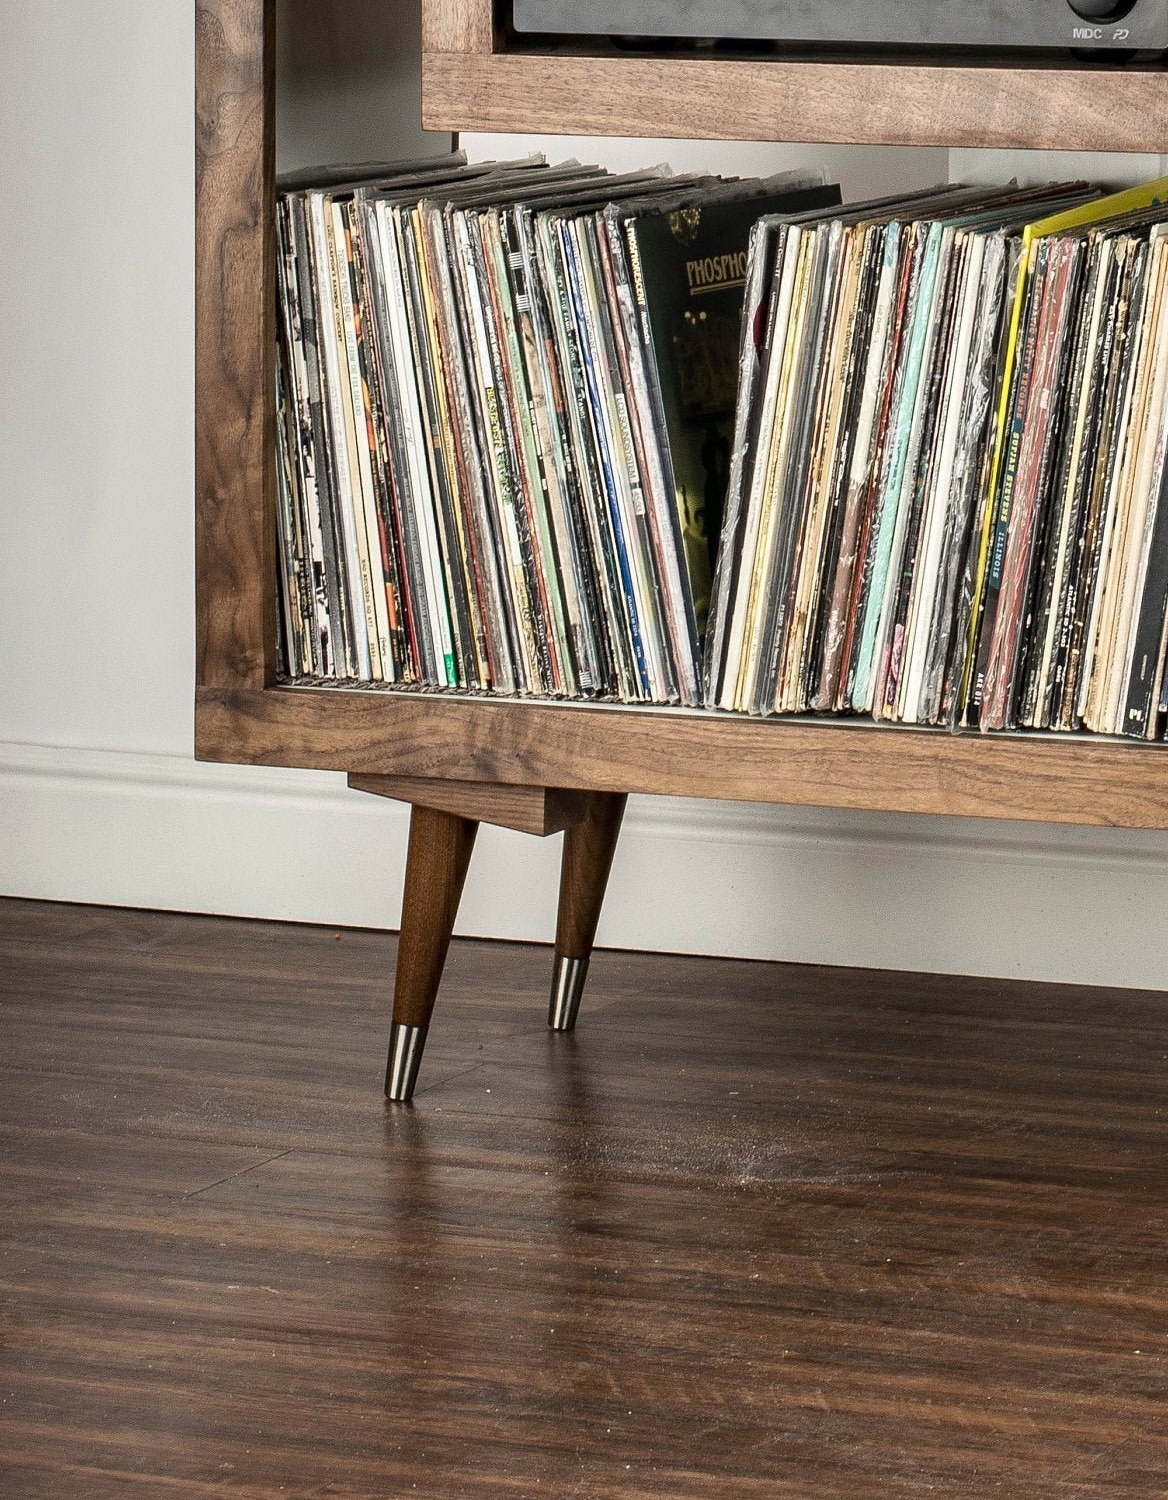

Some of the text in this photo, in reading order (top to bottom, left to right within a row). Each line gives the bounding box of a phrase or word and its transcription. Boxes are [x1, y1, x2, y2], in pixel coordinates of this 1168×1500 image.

[1073, 28, 1102, 39] MDC
[327, 241, 343, 343] CLAPTON'S RAINBOW CONCERT
[626, 226, 651, 345] PHOSPHORESCENT Muchacho
[336, 249, 362, 416] TEDESCHI TRUCKS BAND LIVE FROM THE FOX OAKLAND
[1076, 322, 1086, 348] BROTHERS
[1080, 302, 1088, 322] ALLMAN
[1100, 304, 1114, 365] RAY CHARLES LIVE
[1022, 336, 1034, 369] KITTY
[1074, 347, 1082, 363] BAND
[1014, 371, 1029, 420] RECORDS
[1070, 369, 1079, 393] FILLMORE
[615, 396, 637, 479] LCD SOUNDSYSTEM
[999, 431, 1020, 523] SUFJAN STEVENS
[991, 531, 1005, 579] ILLINOIS
[362, 573, 370, 603] RECORDS
[1059, 584, 1074, 648] ATLANTIC SD 2-503
[972, 672, 985, 706] AKR 014
